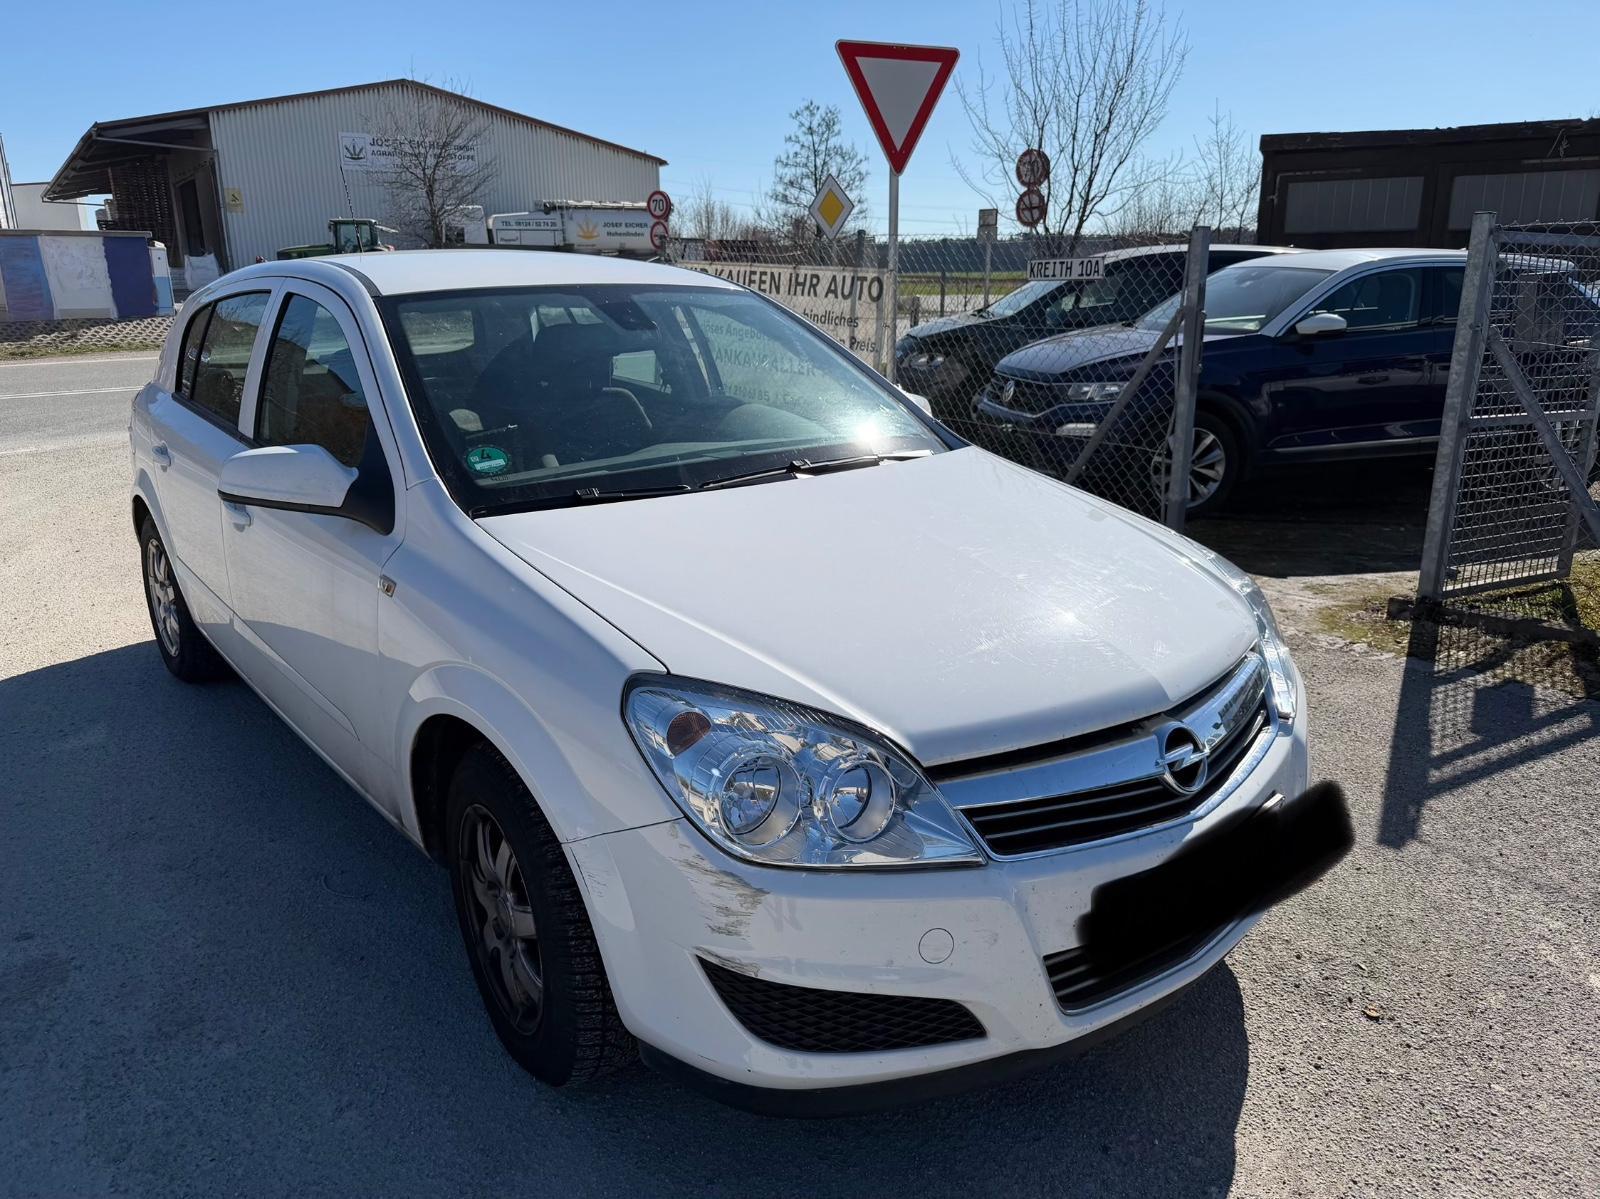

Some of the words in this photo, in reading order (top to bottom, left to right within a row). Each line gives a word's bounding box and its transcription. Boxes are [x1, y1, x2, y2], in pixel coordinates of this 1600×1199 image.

[652, 198, 664, 212] 70
[1029, 261, 1073, 278] KREITH
[1077, 260, 1100, 277] 10A
[787, 272, 820, 297] IHR
[824, 275, 884, 303] AUTO
[481, 449, 492, 459] 4
